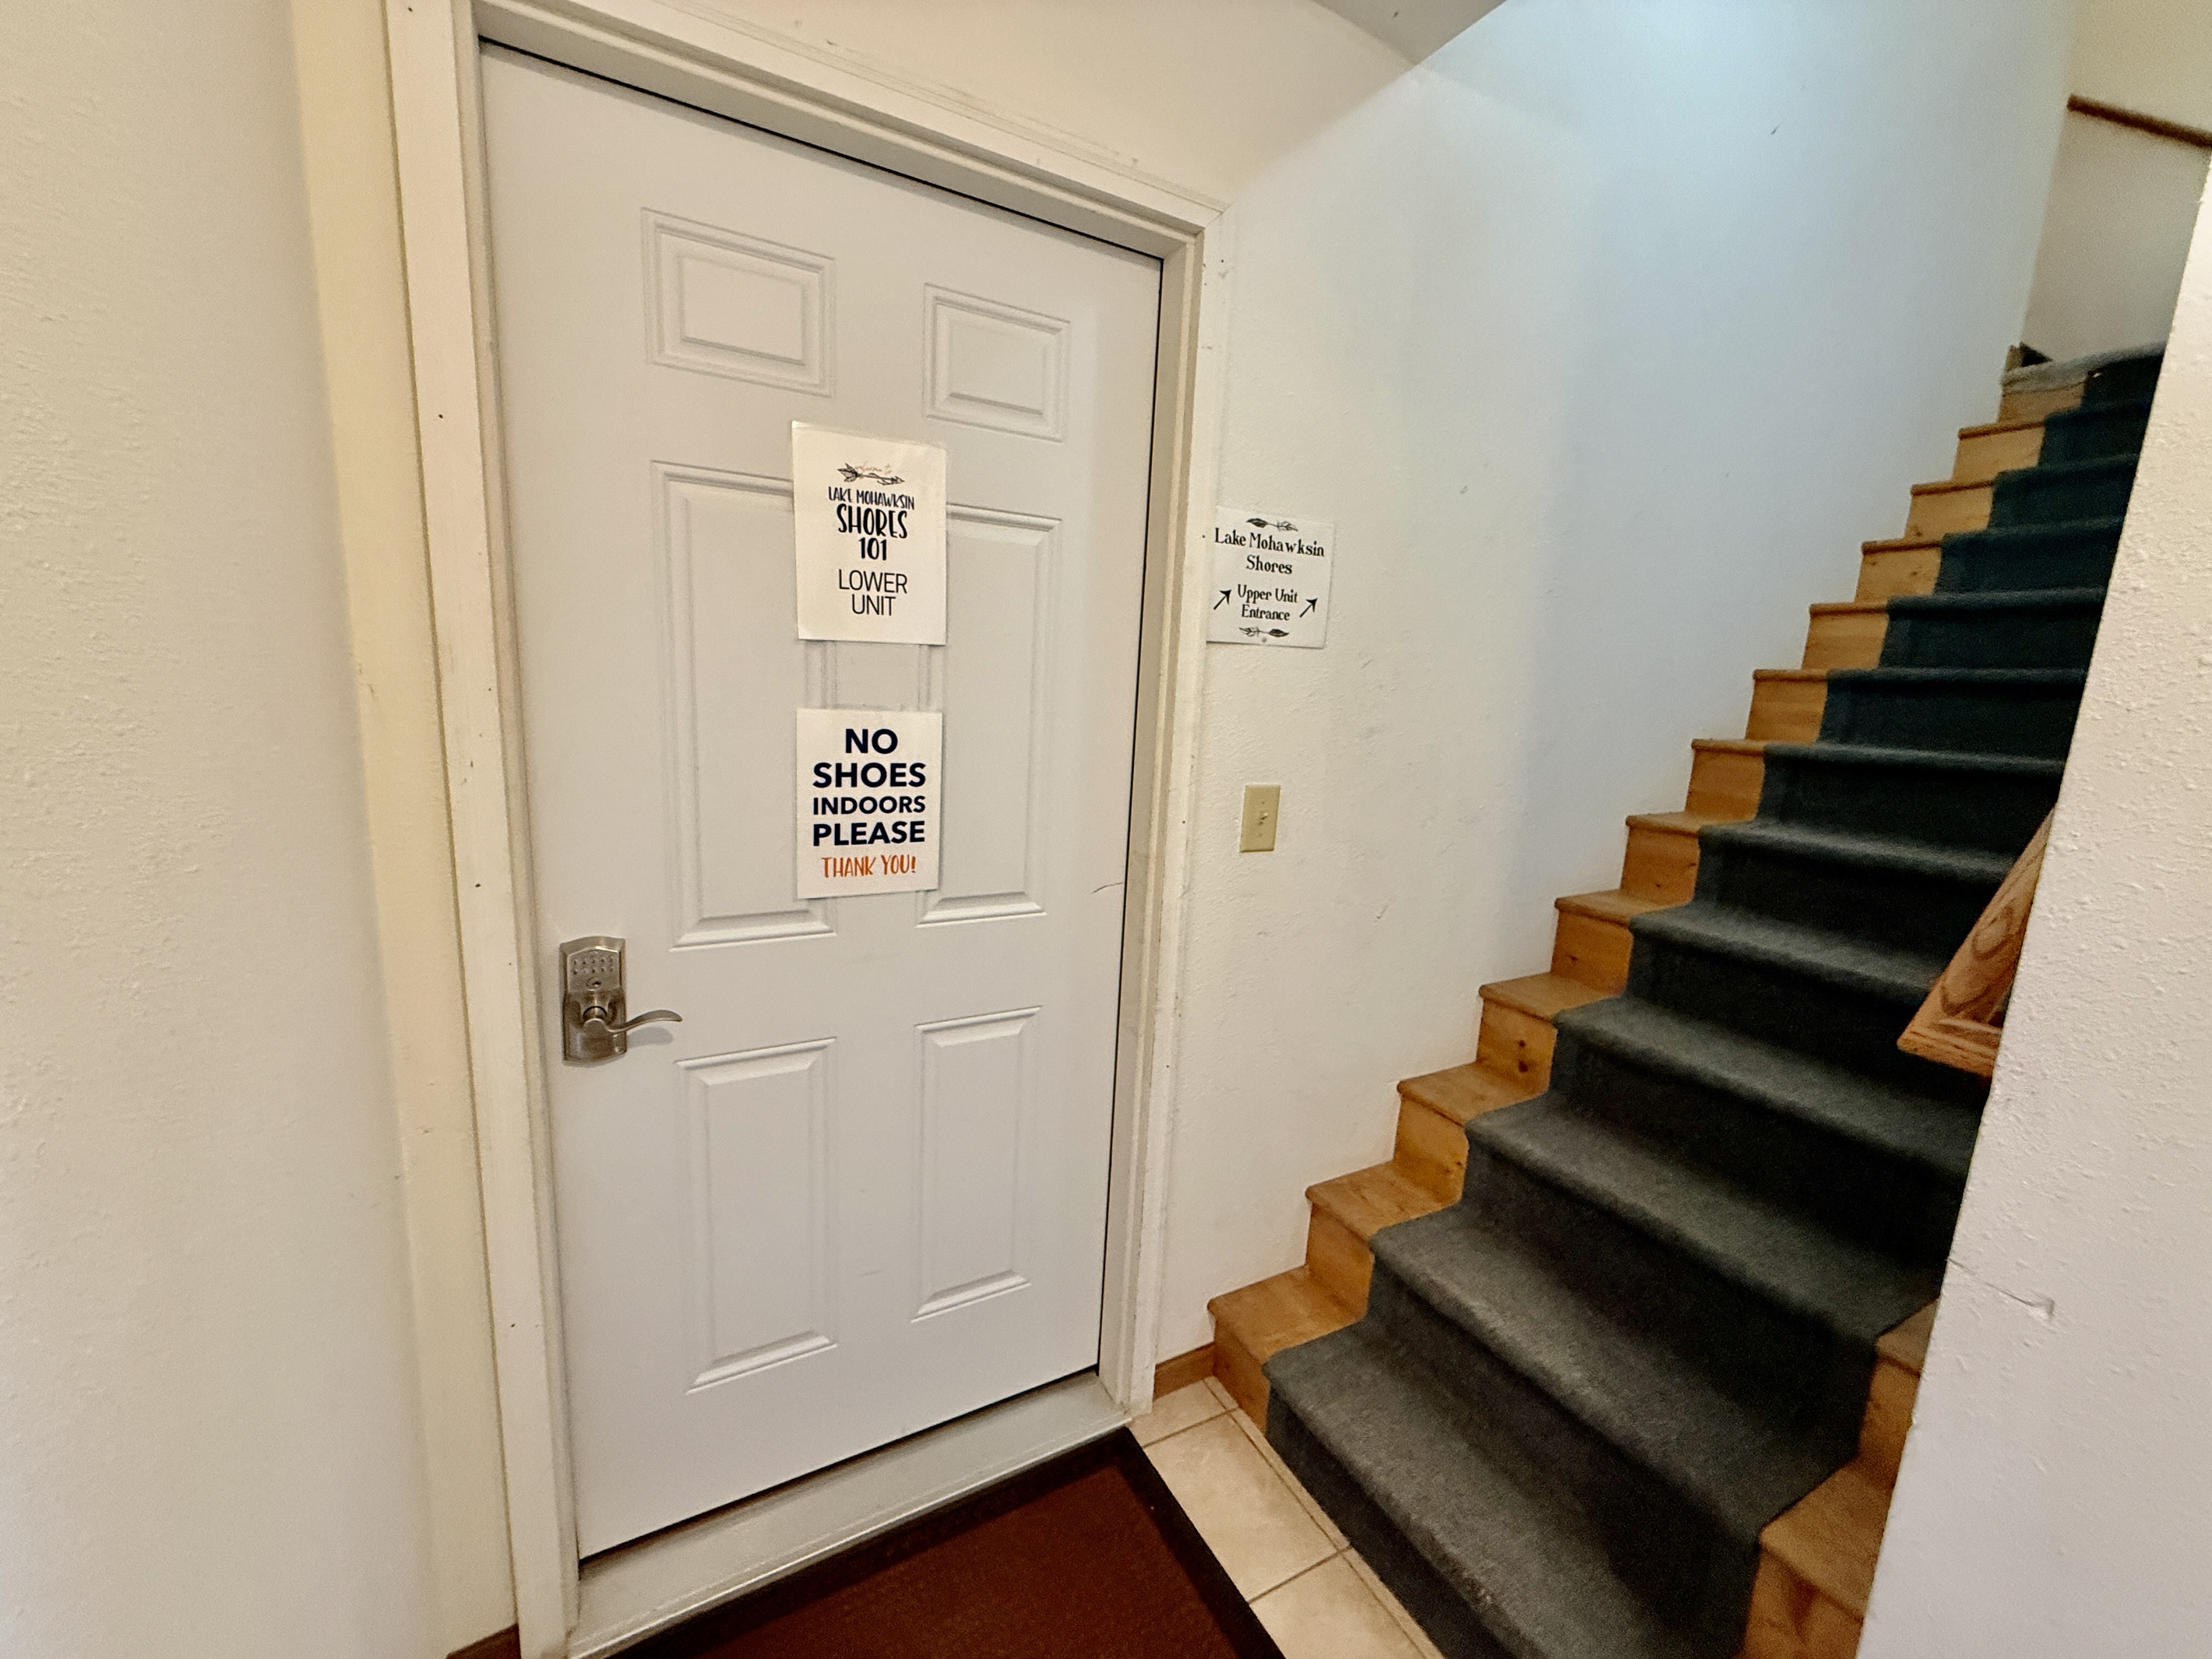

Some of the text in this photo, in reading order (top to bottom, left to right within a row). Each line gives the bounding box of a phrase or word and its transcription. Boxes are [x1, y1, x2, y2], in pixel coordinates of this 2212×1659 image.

[828, 486, 914, 510] LAKE MOHAWKSIN
[837, 503, 908, 539] SHORES
[858, 537, 888, 561] 101
[1214, 527, 1325, 557] Lake Mohawksin
[1246, 555, 1293, 574] Shores
[839, 569, 908, 594] LOWER
[851, 594, 896, 616] UNIT
[1237, 584, 1298, 604] Upper Unit
[1242, 604, 1291, 621] Entrance
[845, 728, 898, 754] NO
[812, 762, 926, 788] SHOES
[812, 795, 926, 815] INDOORS
[813, 820, 925, 847] PLEASE
[821, 854, 917, 879] THANK YOU!
